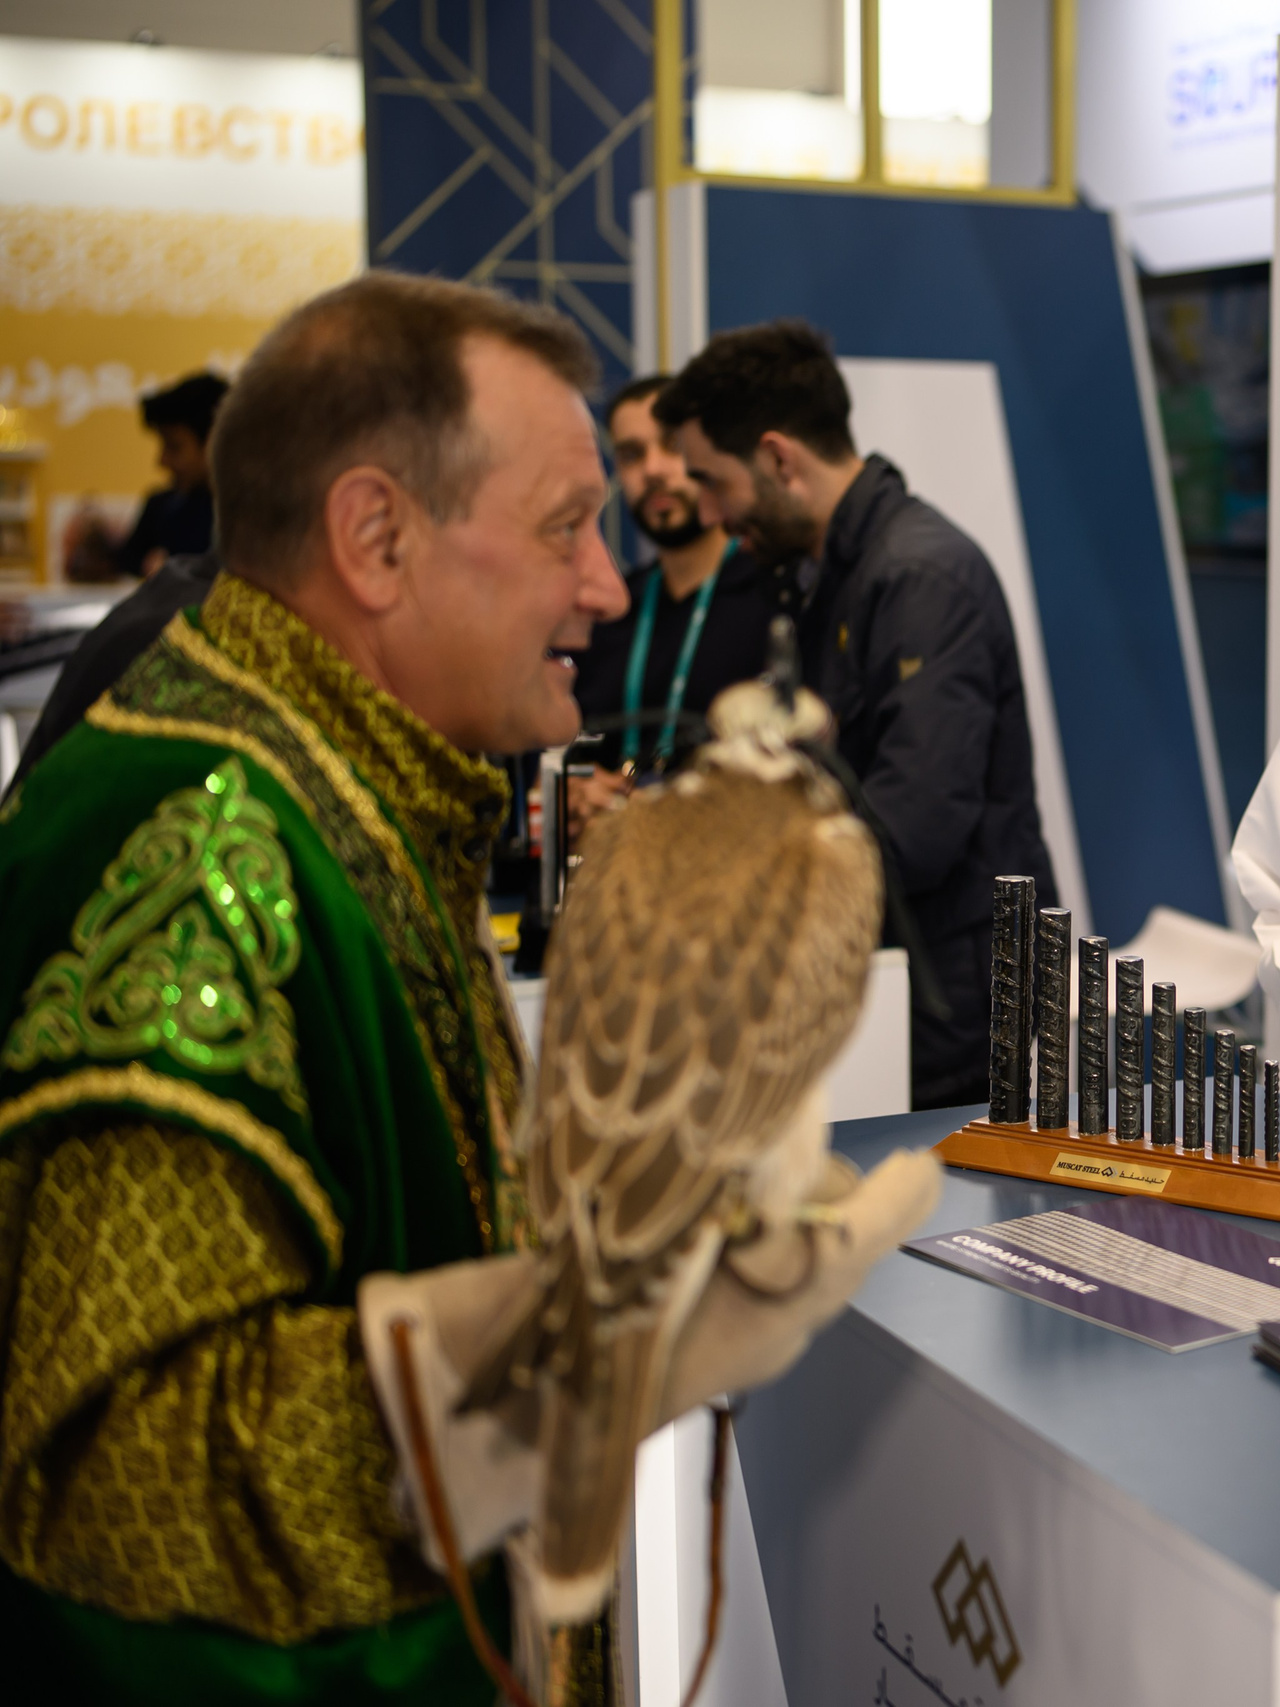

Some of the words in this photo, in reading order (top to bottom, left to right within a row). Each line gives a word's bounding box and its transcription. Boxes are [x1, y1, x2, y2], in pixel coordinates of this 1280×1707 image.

[1057, 1161, 1083, 1172] MUSCAT
[1082, 1166, 1100, 1175] STEEL
[952, 1235, 1036, 1268] COMPANY
[1026, 1264, 1099, 1294] PROFILE
